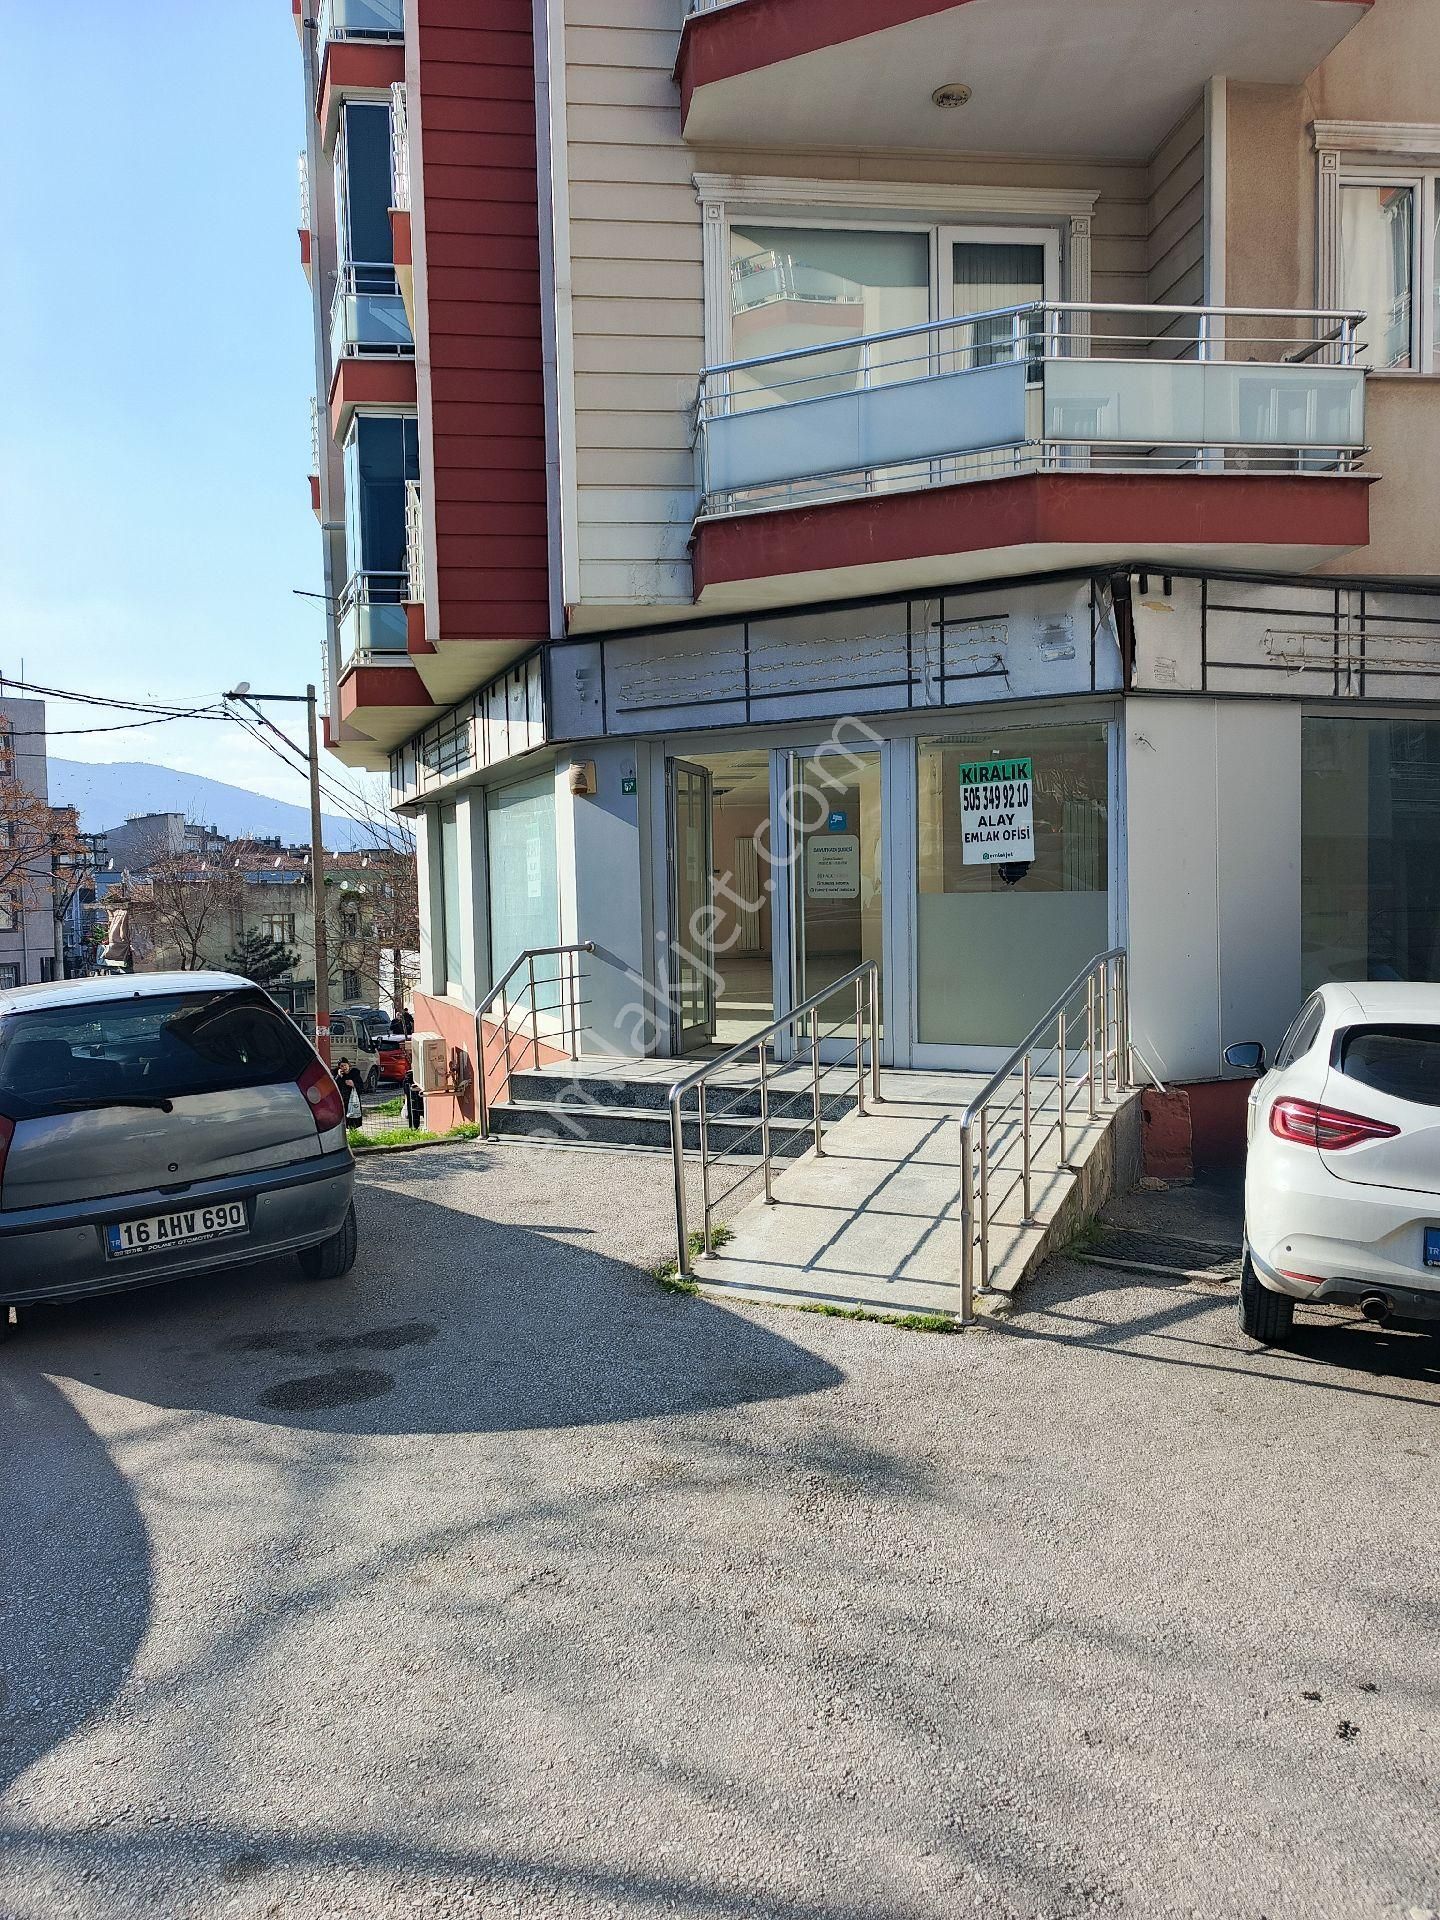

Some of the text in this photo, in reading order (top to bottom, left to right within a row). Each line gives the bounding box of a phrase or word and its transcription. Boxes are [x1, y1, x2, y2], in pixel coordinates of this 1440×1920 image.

[962, 763, 1028, 783] KİRALIK
[963, 783, 1028, 811] 505 349 92 10
[978, 814, 1015, 827] ALAY
[964, 826, 1030, 843] EMLAK OFİSİ
[124, 1222, 150, 1245] 16
[158, 1213, 195, 1239] AHV
[202, 1205, 241, 1229] 690
[1428, 1246, 1440, 1256] TR
